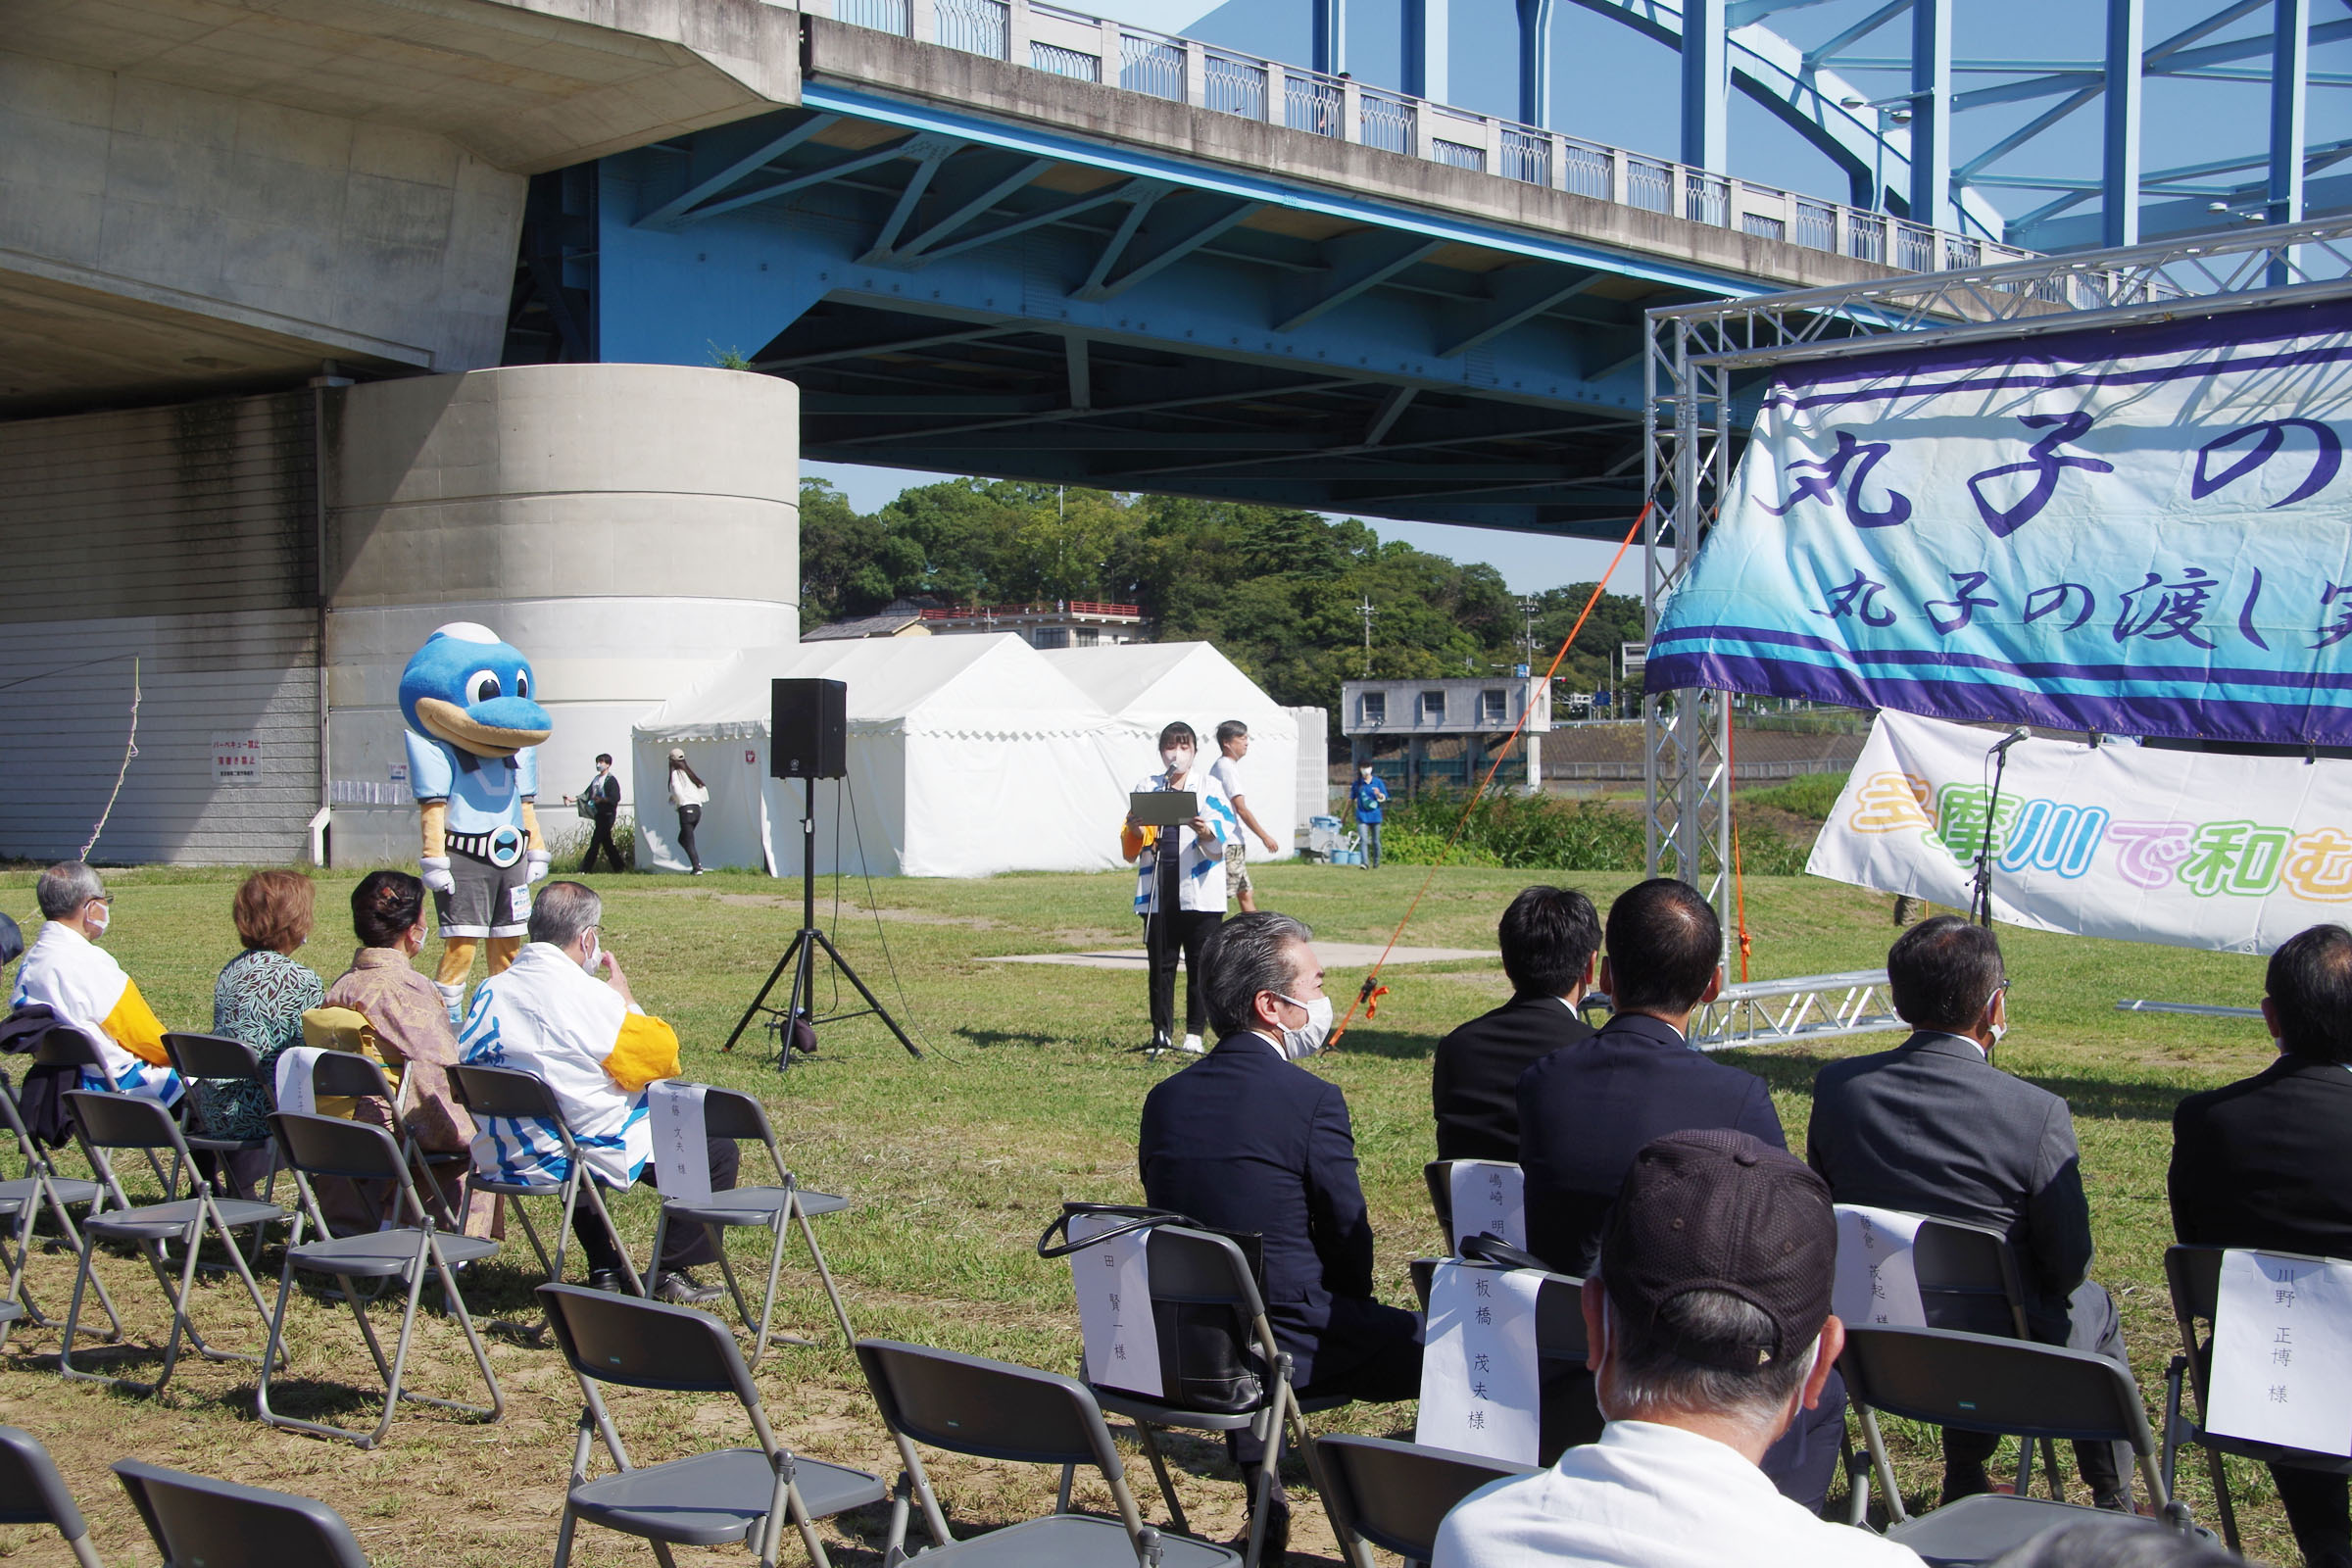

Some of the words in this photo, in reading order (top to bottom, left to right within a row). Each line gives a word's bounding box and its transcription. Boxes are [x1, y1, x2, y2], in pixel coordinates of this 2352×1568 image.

[1752, 411, 2343, 538] 丸子の
[1492, 1219, 1504, 1234] 明
[1475, 1278, 1492, 1326] 板橋
[2275, 1269, 2295, 1308] 川野
[2271, 1327, 2292, 1367] 正博
[2268, 1384, 2288, 1403] 様
